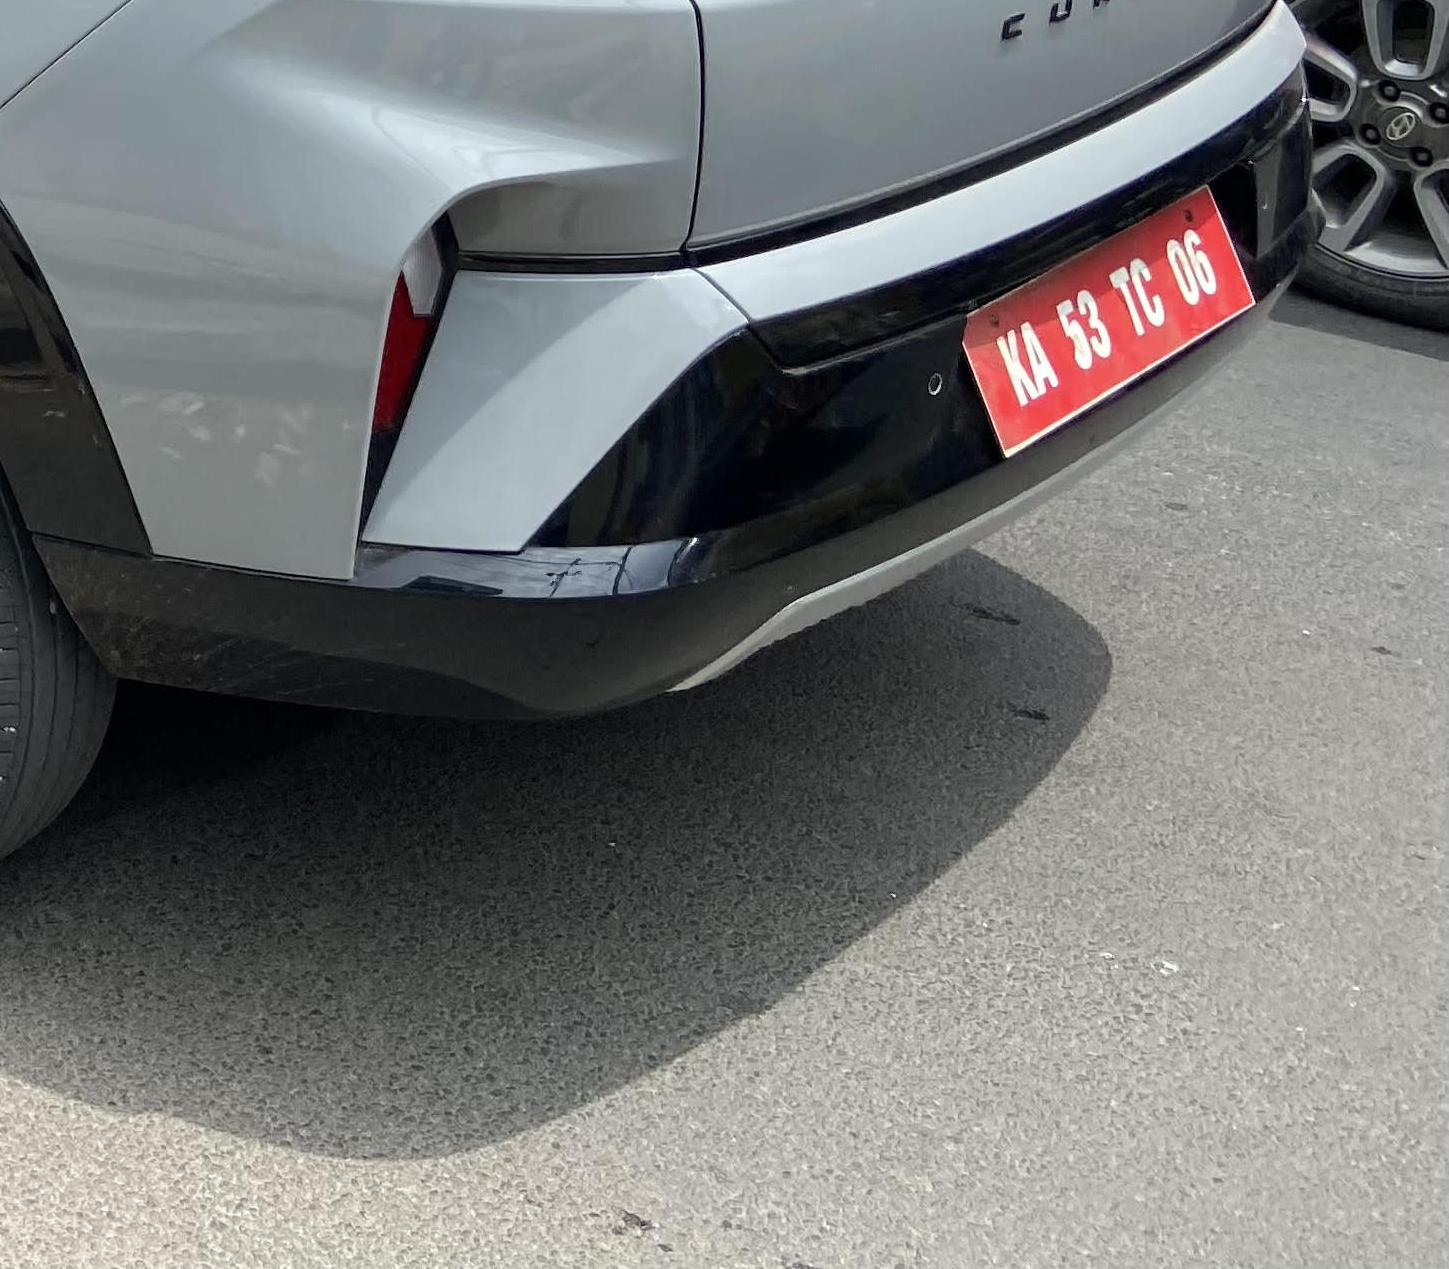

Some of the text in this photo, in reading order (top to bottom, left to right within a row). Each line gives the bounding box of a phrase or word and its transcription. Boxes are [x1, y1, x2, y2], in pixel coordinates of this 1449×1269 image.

[996, 229, 1218, 408] KA 53 TC 06
